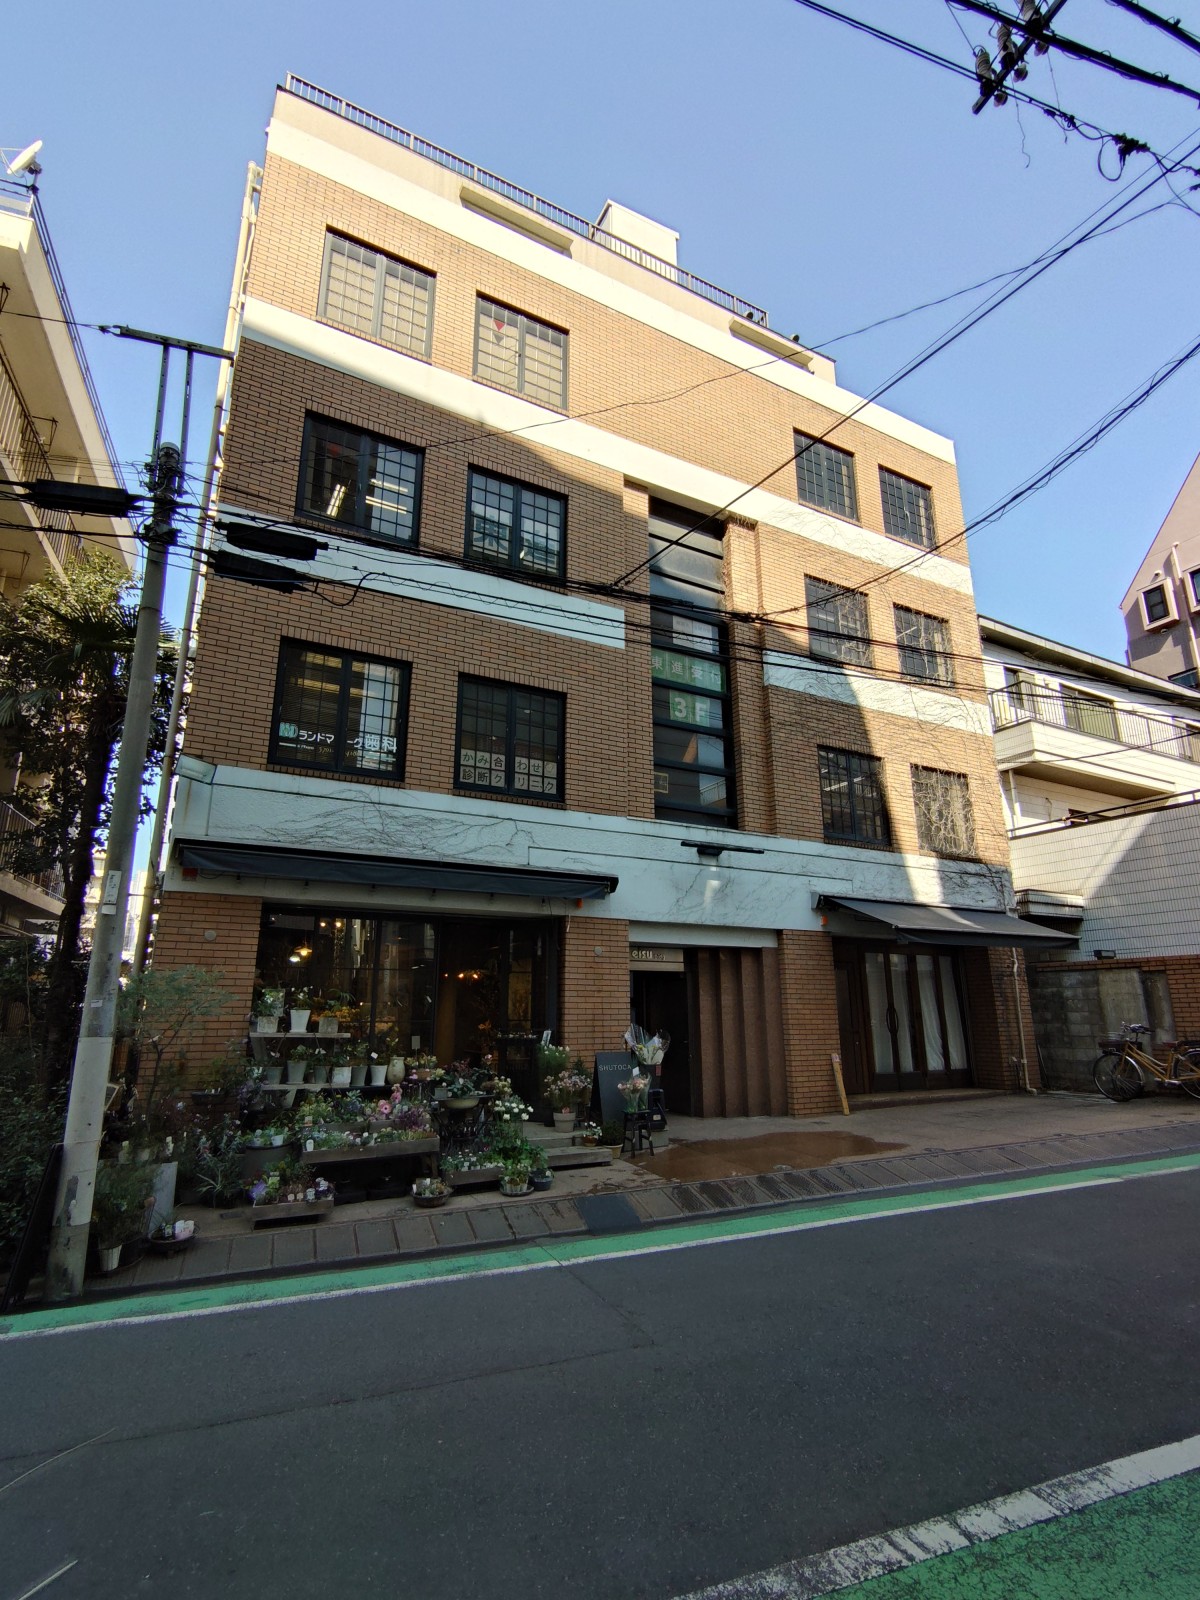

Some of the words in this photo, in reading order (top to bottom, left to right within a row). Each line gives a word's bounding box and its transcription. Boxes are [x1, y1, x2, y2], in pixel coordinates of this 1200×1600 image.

[651, 656, 721, 684] 東進受付
[674, 697, 707, 722] 3F
[462, 752, 541, 773] かみ合わせ
[462, 769, 554, 791] 診断クリニック
